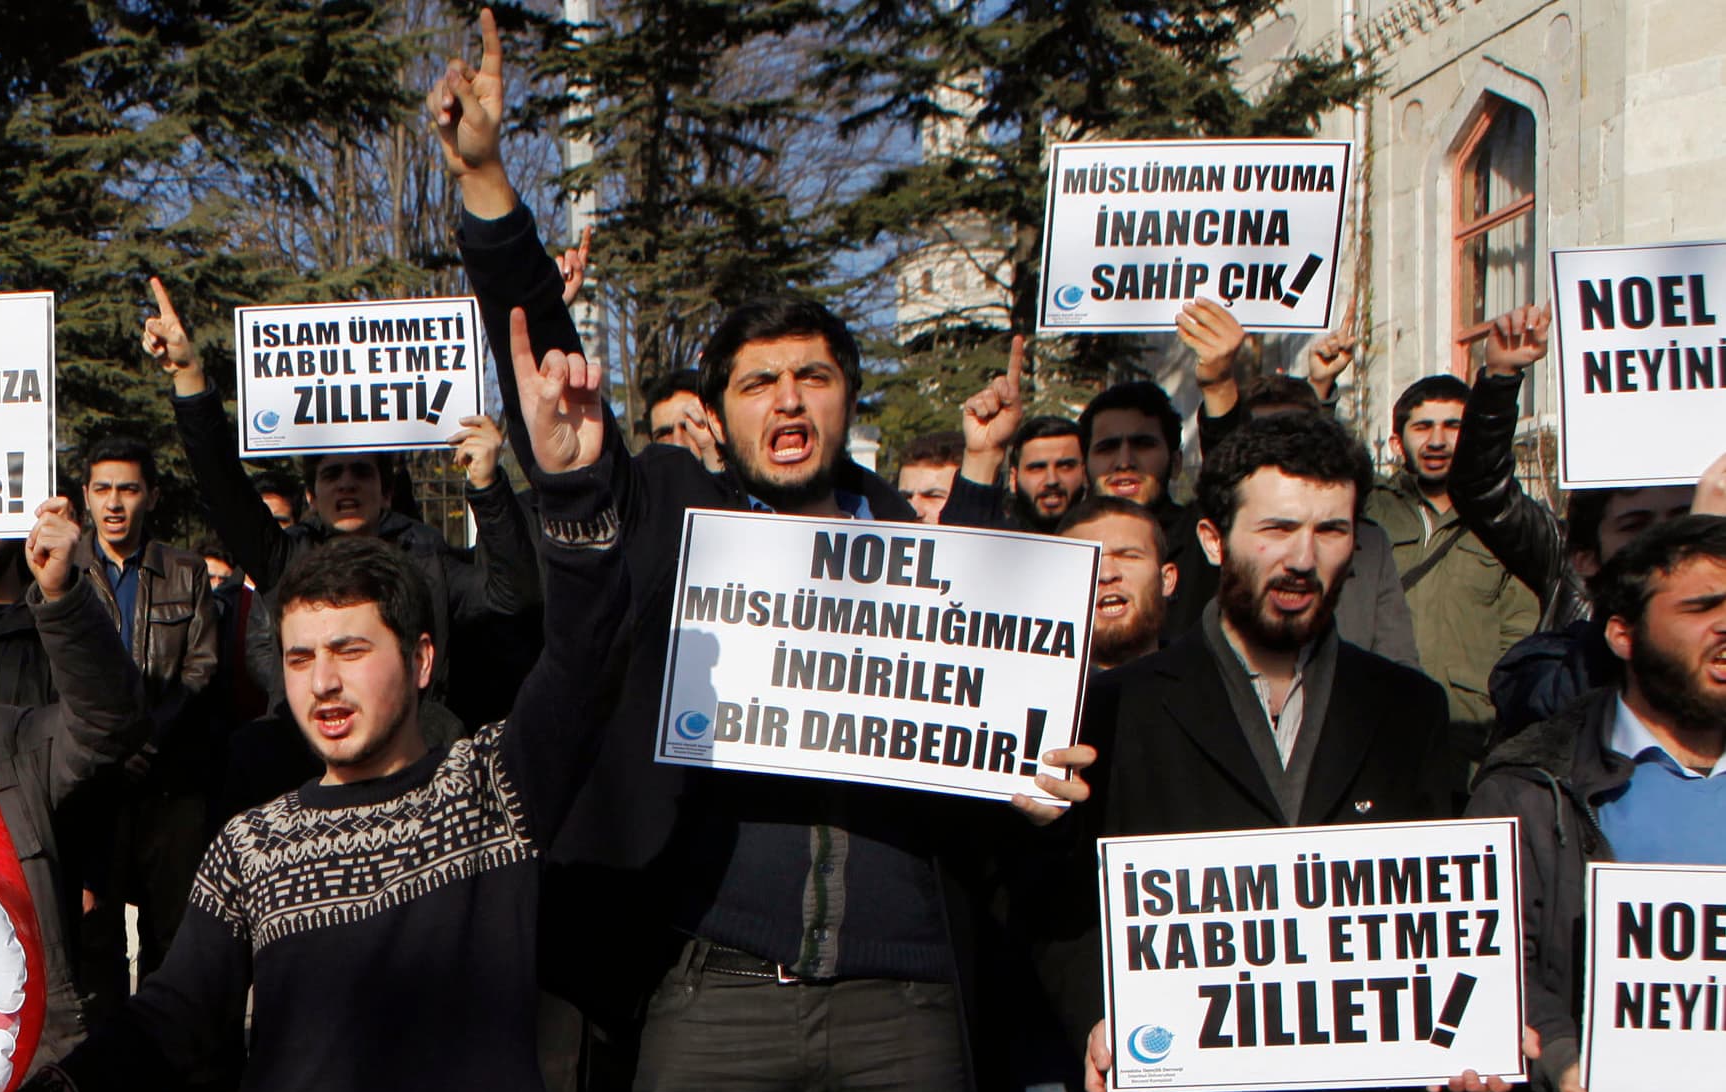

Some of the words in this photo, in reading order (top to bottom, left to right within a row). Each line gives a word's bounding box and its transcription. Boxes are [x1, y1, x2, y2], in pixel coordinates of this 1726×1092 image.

[1062, 161, 1226, 195] MÜSLÜMAN
[1232, 164, 1335, 193] UYUMA
[1094, 204, 1290, 247] İNANCINA
[1090, 257, 1209, 301] SAHİP
[1218, 252, 1324, 309] ÇIK!
[1578, 273, 1716, 331] NOEL
[252, 321, 341, 348] İSLAM
[349, 312, 466, 345] ÜMMETİ
[253, 349, 357, 379] KABUL
[368, 344, 467, 374] ETMEZ
[294, 374, 453, 426] ZİLLETİ!
[810, 531, 952, 596] NOEL,
[684, 582, 1076, 659] MÜSLÜMANLIĞIMIZA
[770, 640, 985, 708] İNDİRİLEN
[713, 697, 790, 748] BİR
[799, 707, 1048, 777] DARBEDİR!
[1123, 863, 1279, 917] İSLAM
[1293, 845, 1499, 909] ÜMMETİ
[1126, 917, 1308, 971] KABUL
[1329, 909, 1500, 963] ETMEZ
[1198, 963, 1478, 1049] ZİLLETİ!
[1614, 975, 1726, 1031] NEYİ
